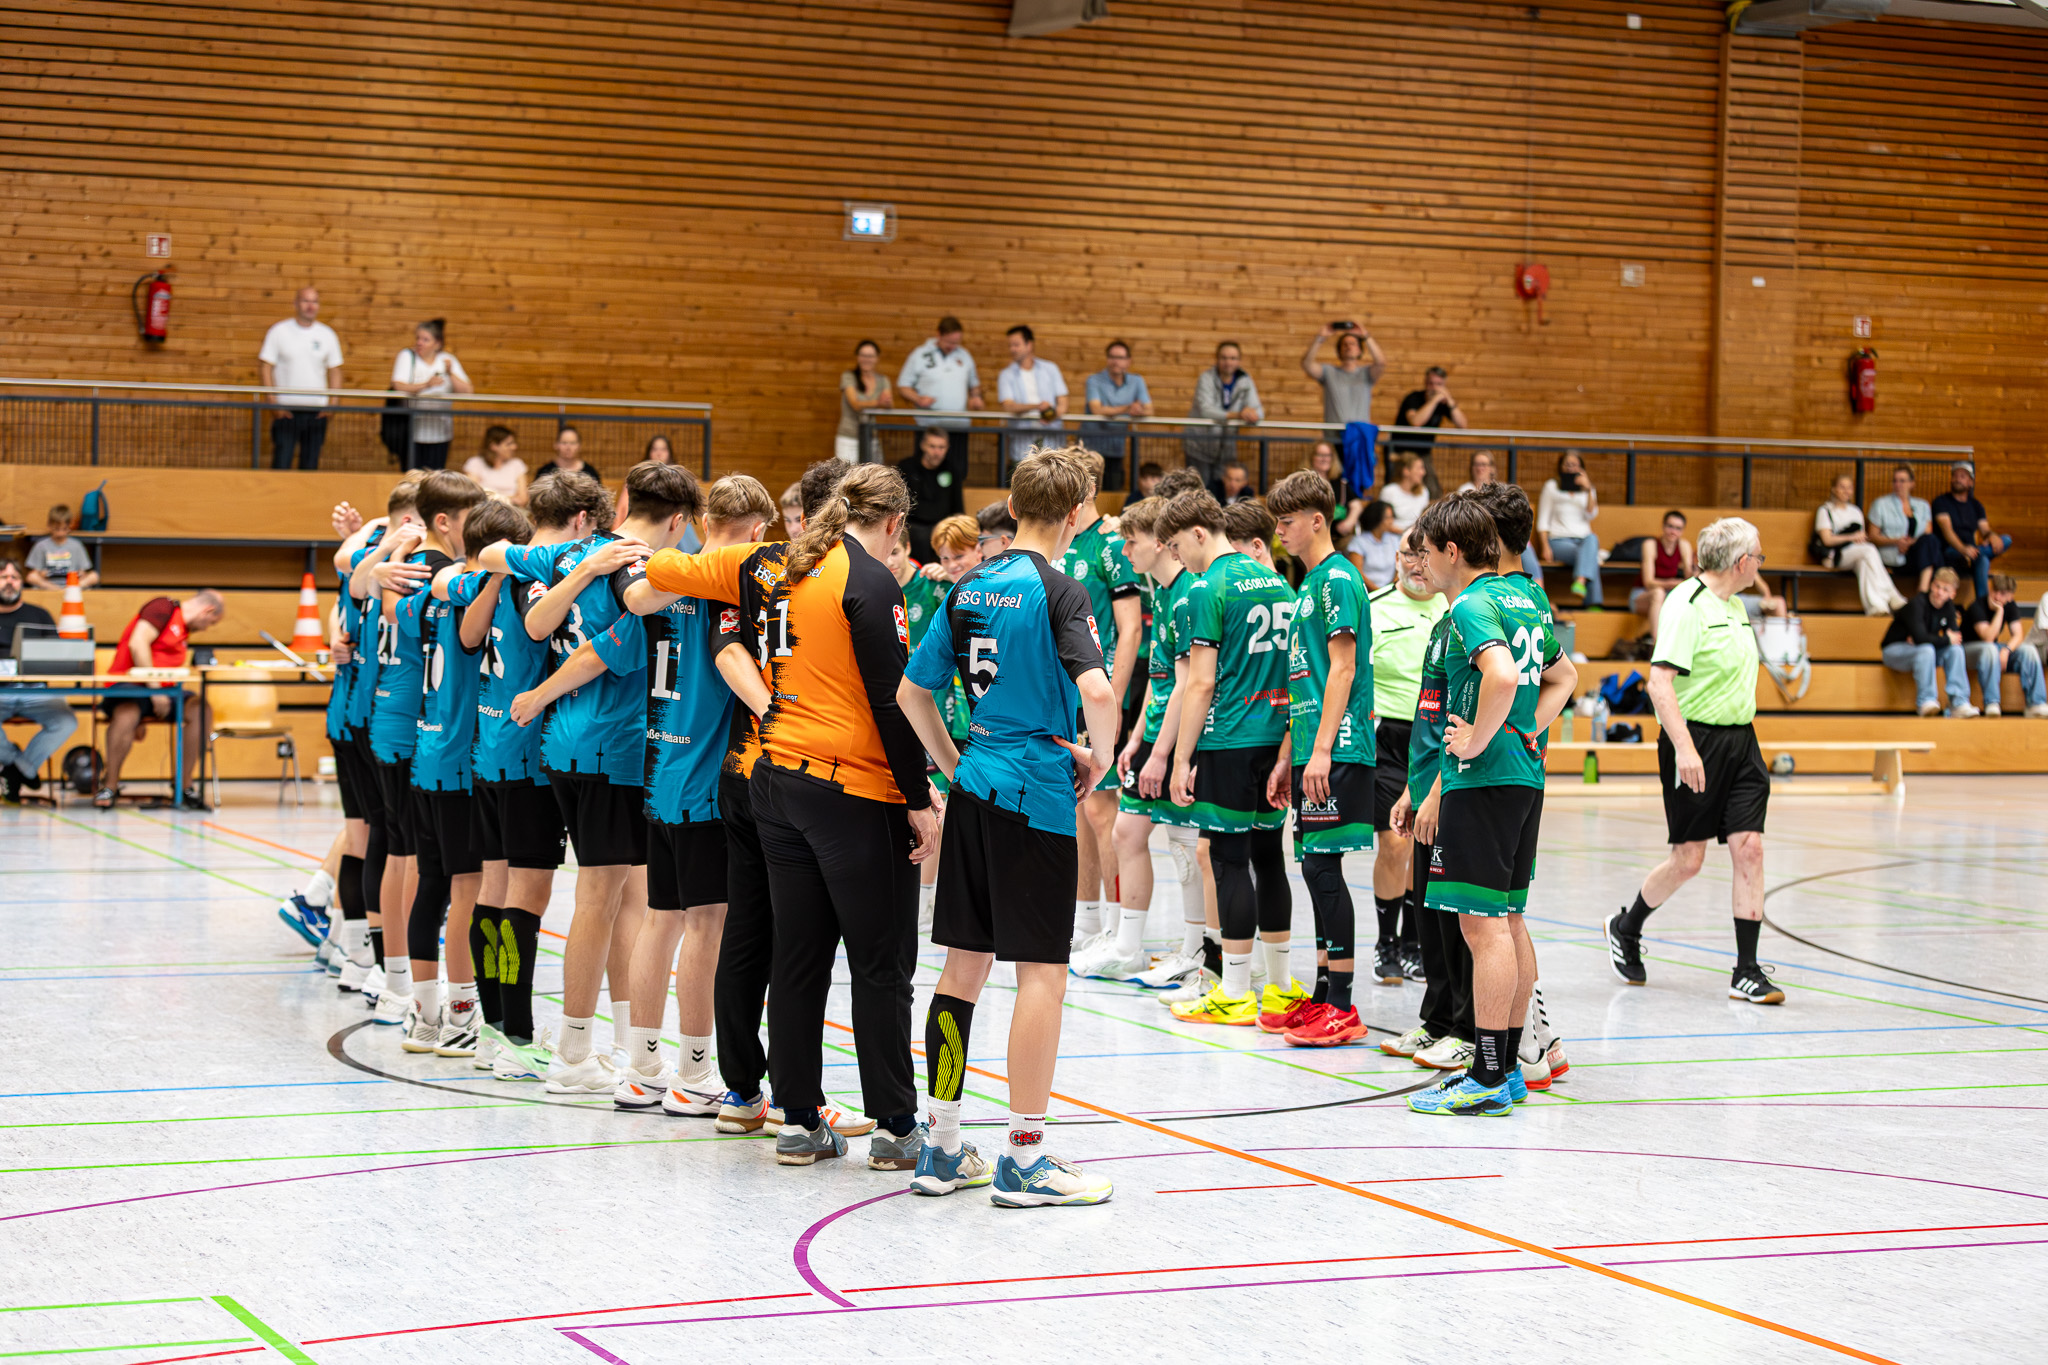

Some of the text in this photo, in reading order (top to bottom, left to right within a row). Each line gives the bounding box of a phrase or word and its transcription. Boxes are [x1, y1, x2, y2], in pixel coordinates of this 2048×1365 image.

[754, 565, 777, 586] HSG
[955, 590, 1023, 609] HSG Wesel
[377, 614, 401, 665] 21
[1246, 601, 1290, 655] 25
[969, 637, 998, 700] 5
[1512, 625, 1544, 686] 29
[1339, 715, 1352, 748] TUS
[1440, 904, 1459, 913] Kempa
[1469, 908, 1489, 917] Kempa
[1481, 1035, 1499, 1071] MUSTANG
